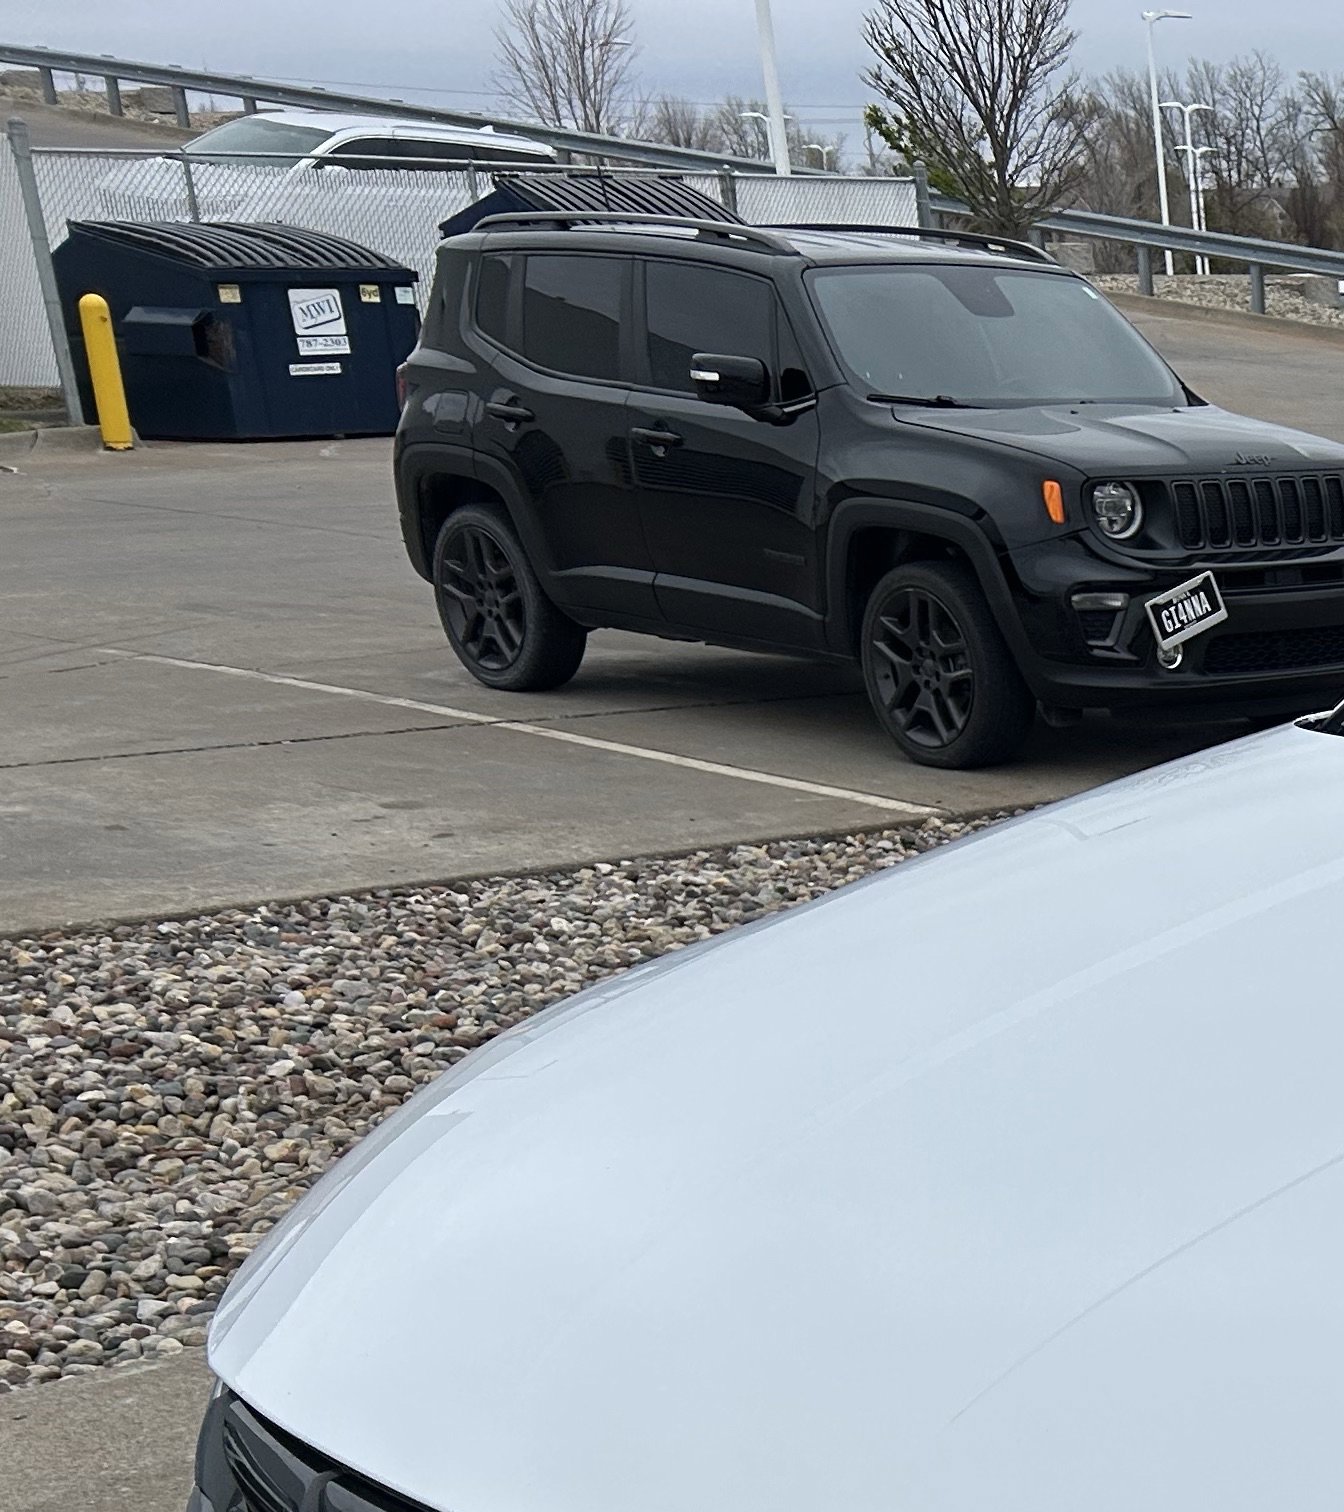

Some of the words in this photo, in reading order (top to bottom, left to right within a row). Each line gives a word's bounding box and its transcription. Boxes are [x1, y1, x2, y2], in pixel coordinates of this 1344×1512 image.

[299, 338, 348, 348] 787-2303
[1234, 451, 1272, 467] Jeep
[1161, 591, 1212, 633] GI4NNA
